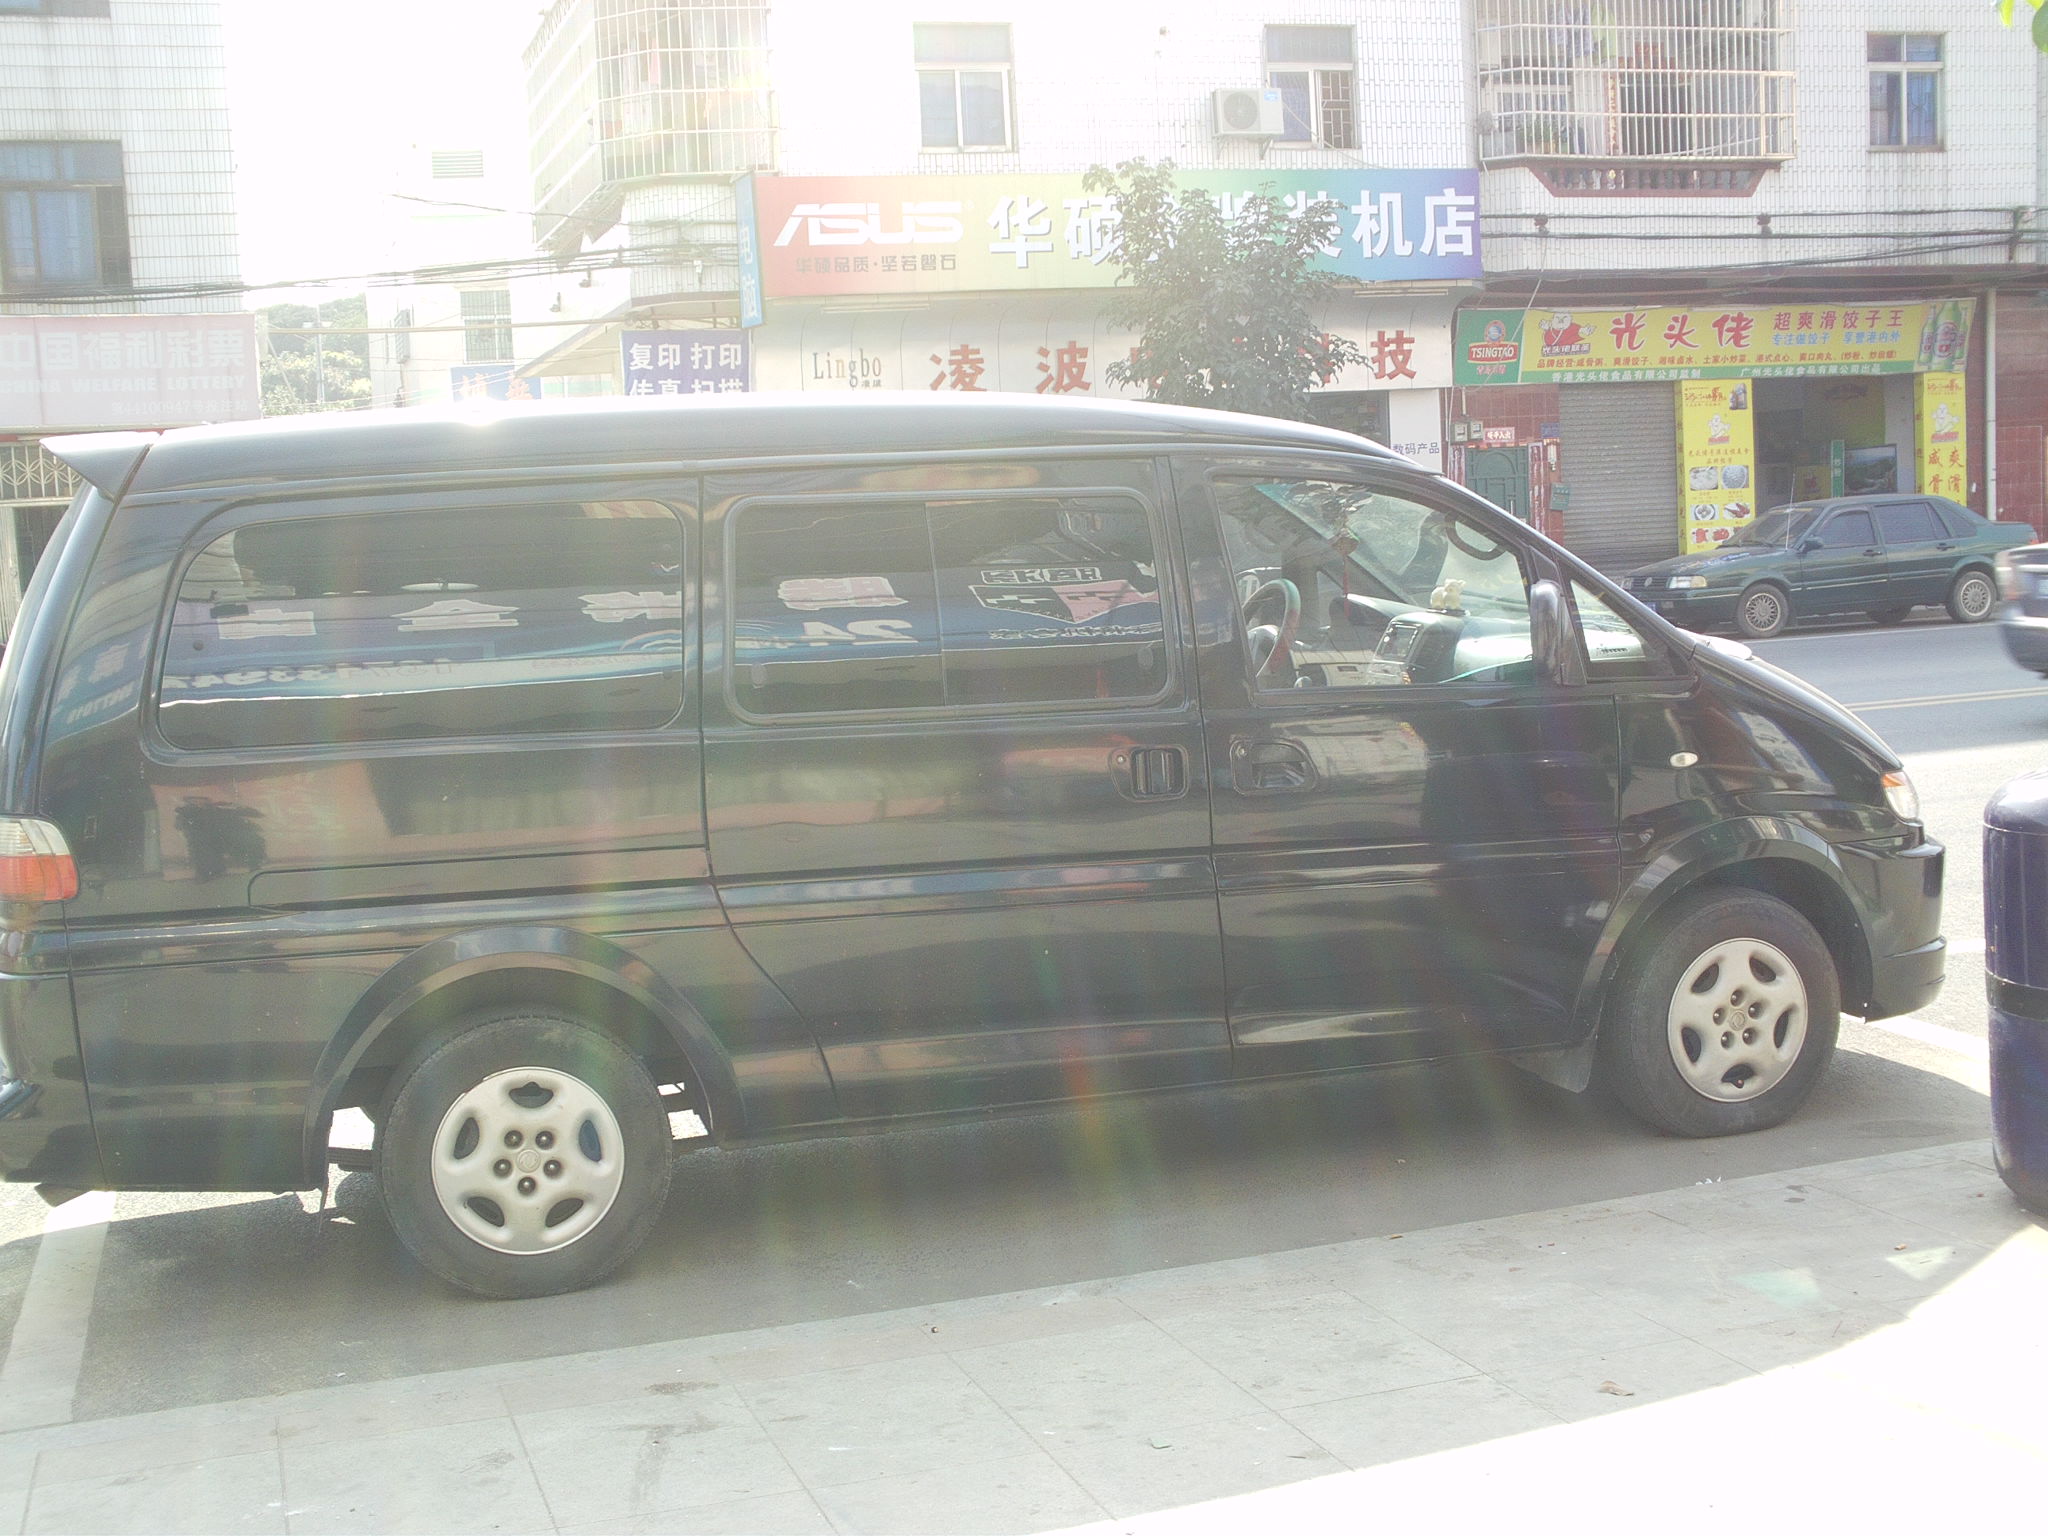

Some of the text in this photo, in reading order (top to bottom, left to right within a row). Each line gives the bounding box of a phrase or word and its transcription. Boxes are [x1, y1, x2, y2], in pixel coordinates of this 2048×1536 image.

[773, 201, 963, 247] ASUS
[1609, 311, 1754, 350] 光头佬
[1773, 309, 1905, 331] 超爽滑饺子王
[0, 329, 245, 370] 中国福利彩票
[629, 343, 741, 371] 复印 打印
[1471, 346, 1514, 359] TSINGTAO
[813, 349, 881, 389] Lingbo
[71, 377, 157, 393] WELFARE
[167, 375, 246, 392] LOTTERY
[1392, 442, 1440, 456] 数码产品
